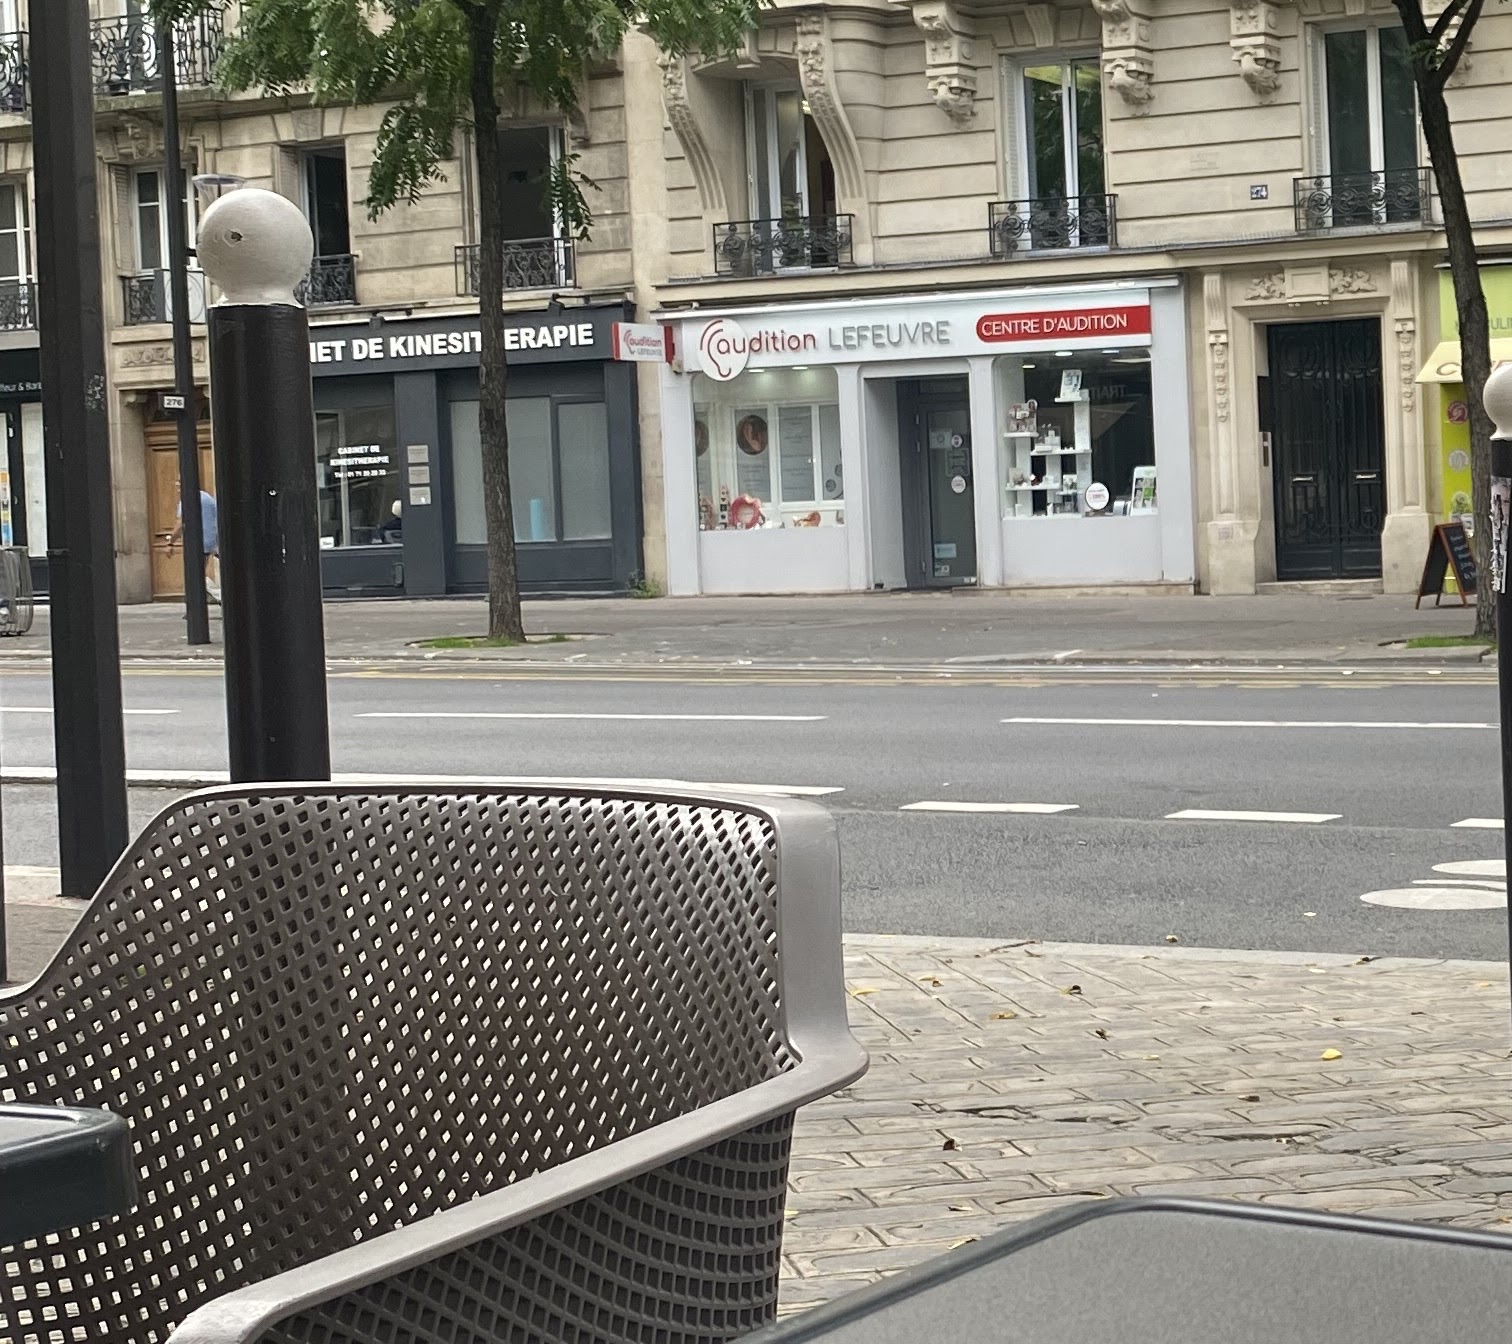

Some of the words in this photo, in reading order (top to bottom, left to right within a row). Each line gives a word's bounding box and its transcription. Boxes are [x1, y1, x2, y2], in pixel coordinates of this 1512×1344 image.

[716, 329, 817, 355] audition
[828, 320, 950, 351] LEFEUVRE
[981, 318, 1040, 337] CENTRE
[1043, 313, 1128, 333] D'AUDITION
[351, 337, 384, 361] DE
[390, 323, 594, 358] KINESITERAPIE
[166, 398, 183, 407] 276
